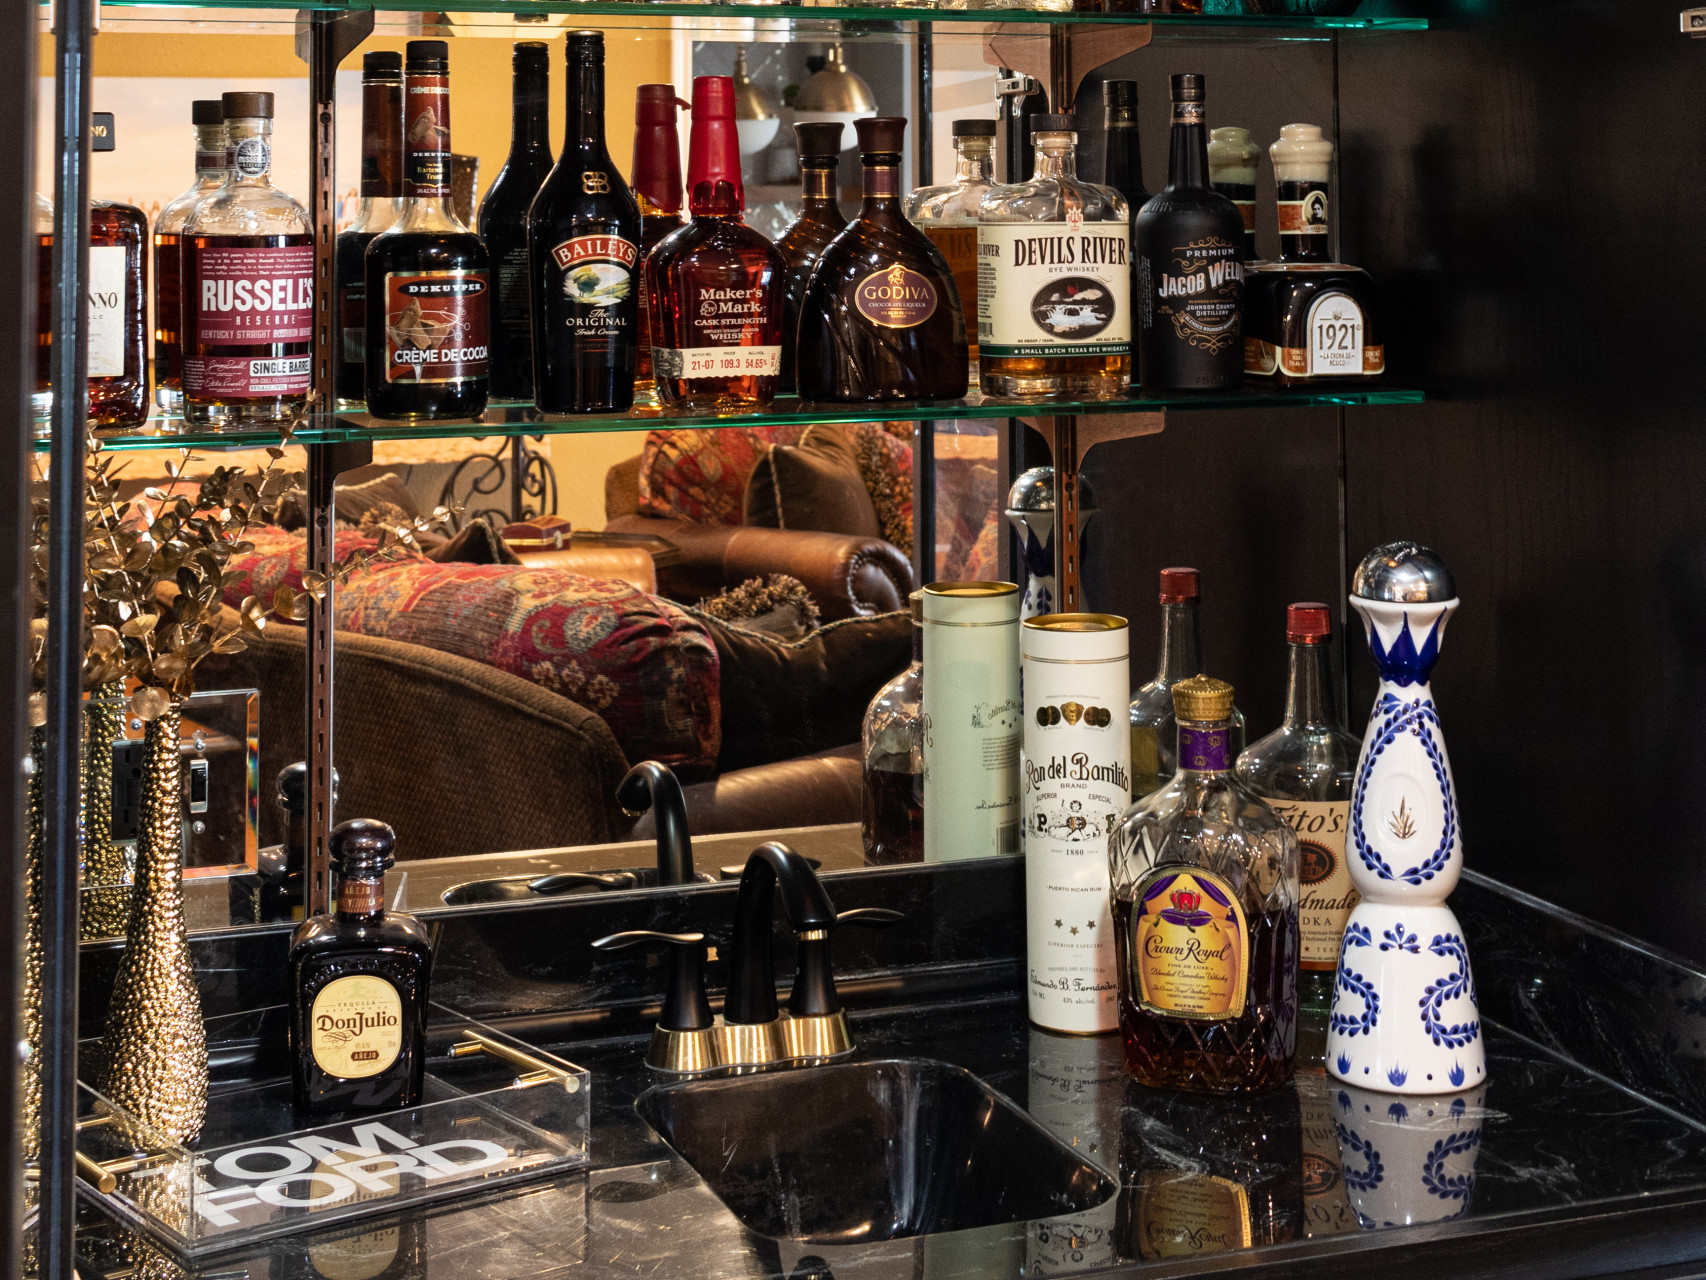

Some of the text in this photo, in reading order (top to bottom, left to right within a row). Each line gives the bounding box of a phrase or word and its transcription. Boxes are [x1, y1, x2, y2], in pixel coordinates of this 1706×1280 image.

[558, 239, 635, 263] BAILEYS
[1013, 235, 1127, 267] DEVILS RIVER
[1186, 248, 1235, 258] PREMIUM
[408, 282, 482, 293] DEKUYPER
[1158, 272, 1206, 298] JACOB
[201, 279, 314, 313] RUSSELL'S
[698, 287, 763, 300] Maker's
[864, 286, 930, 300] GODIVA
[589, 308, 611, 318] The
[718, 301, 762, 314] Mark
[1185, 303, 1215, 311] JOHNSON
[235, 314, 297, 326] RESERVE
[565, 317, 627, 327] ORIGINAL
[694, 316, 768, 327] CASK STRENGTH
[201, 329, 272, 340] KENTUCKY STRAIGHT
[575, 327, 620, 336] Irish Cream
[710, 332, 754, 340] WHISKY
[1317, 323, 1356, 351] 1921
[394, 346, 488, 363] CRÈME DE COCOA
[1044, 347, 1066, 355] BATCH
[1088, 346, 1101, 354] RYE
[1101, 345, 1126, 353] WHISKEY
[252, 362, 287, 375] SINGLE
[691, 358, 768, 371] 21-07 109.3 54.65%
[1025, 751, 1129, 795] Ron del Barrilito
[1060, 782, 1088, 790] BRAND
[1036, 792, 1112, 804] SUPERIOR ESPECIAL
[1065, 847, 1085, 857] 1880
[1048, 885, 1102, 893] PUERTO RICAN RUM
[1298, 888, 1356, 911] dmade
[1047, 941, 1075, 949] SUPERIOR
[1144, 934, 1231, 964] Crown Royal
[1150, 967, 1229, 983] Blended Canadian Whisky
[1058, 977, 1072, 992] B.
[338, 1000, 376, 1008] TEQUILA
[353, 1050, 378, 1060] AÑEJO
[190, 1138, 510, 1228] FORD
